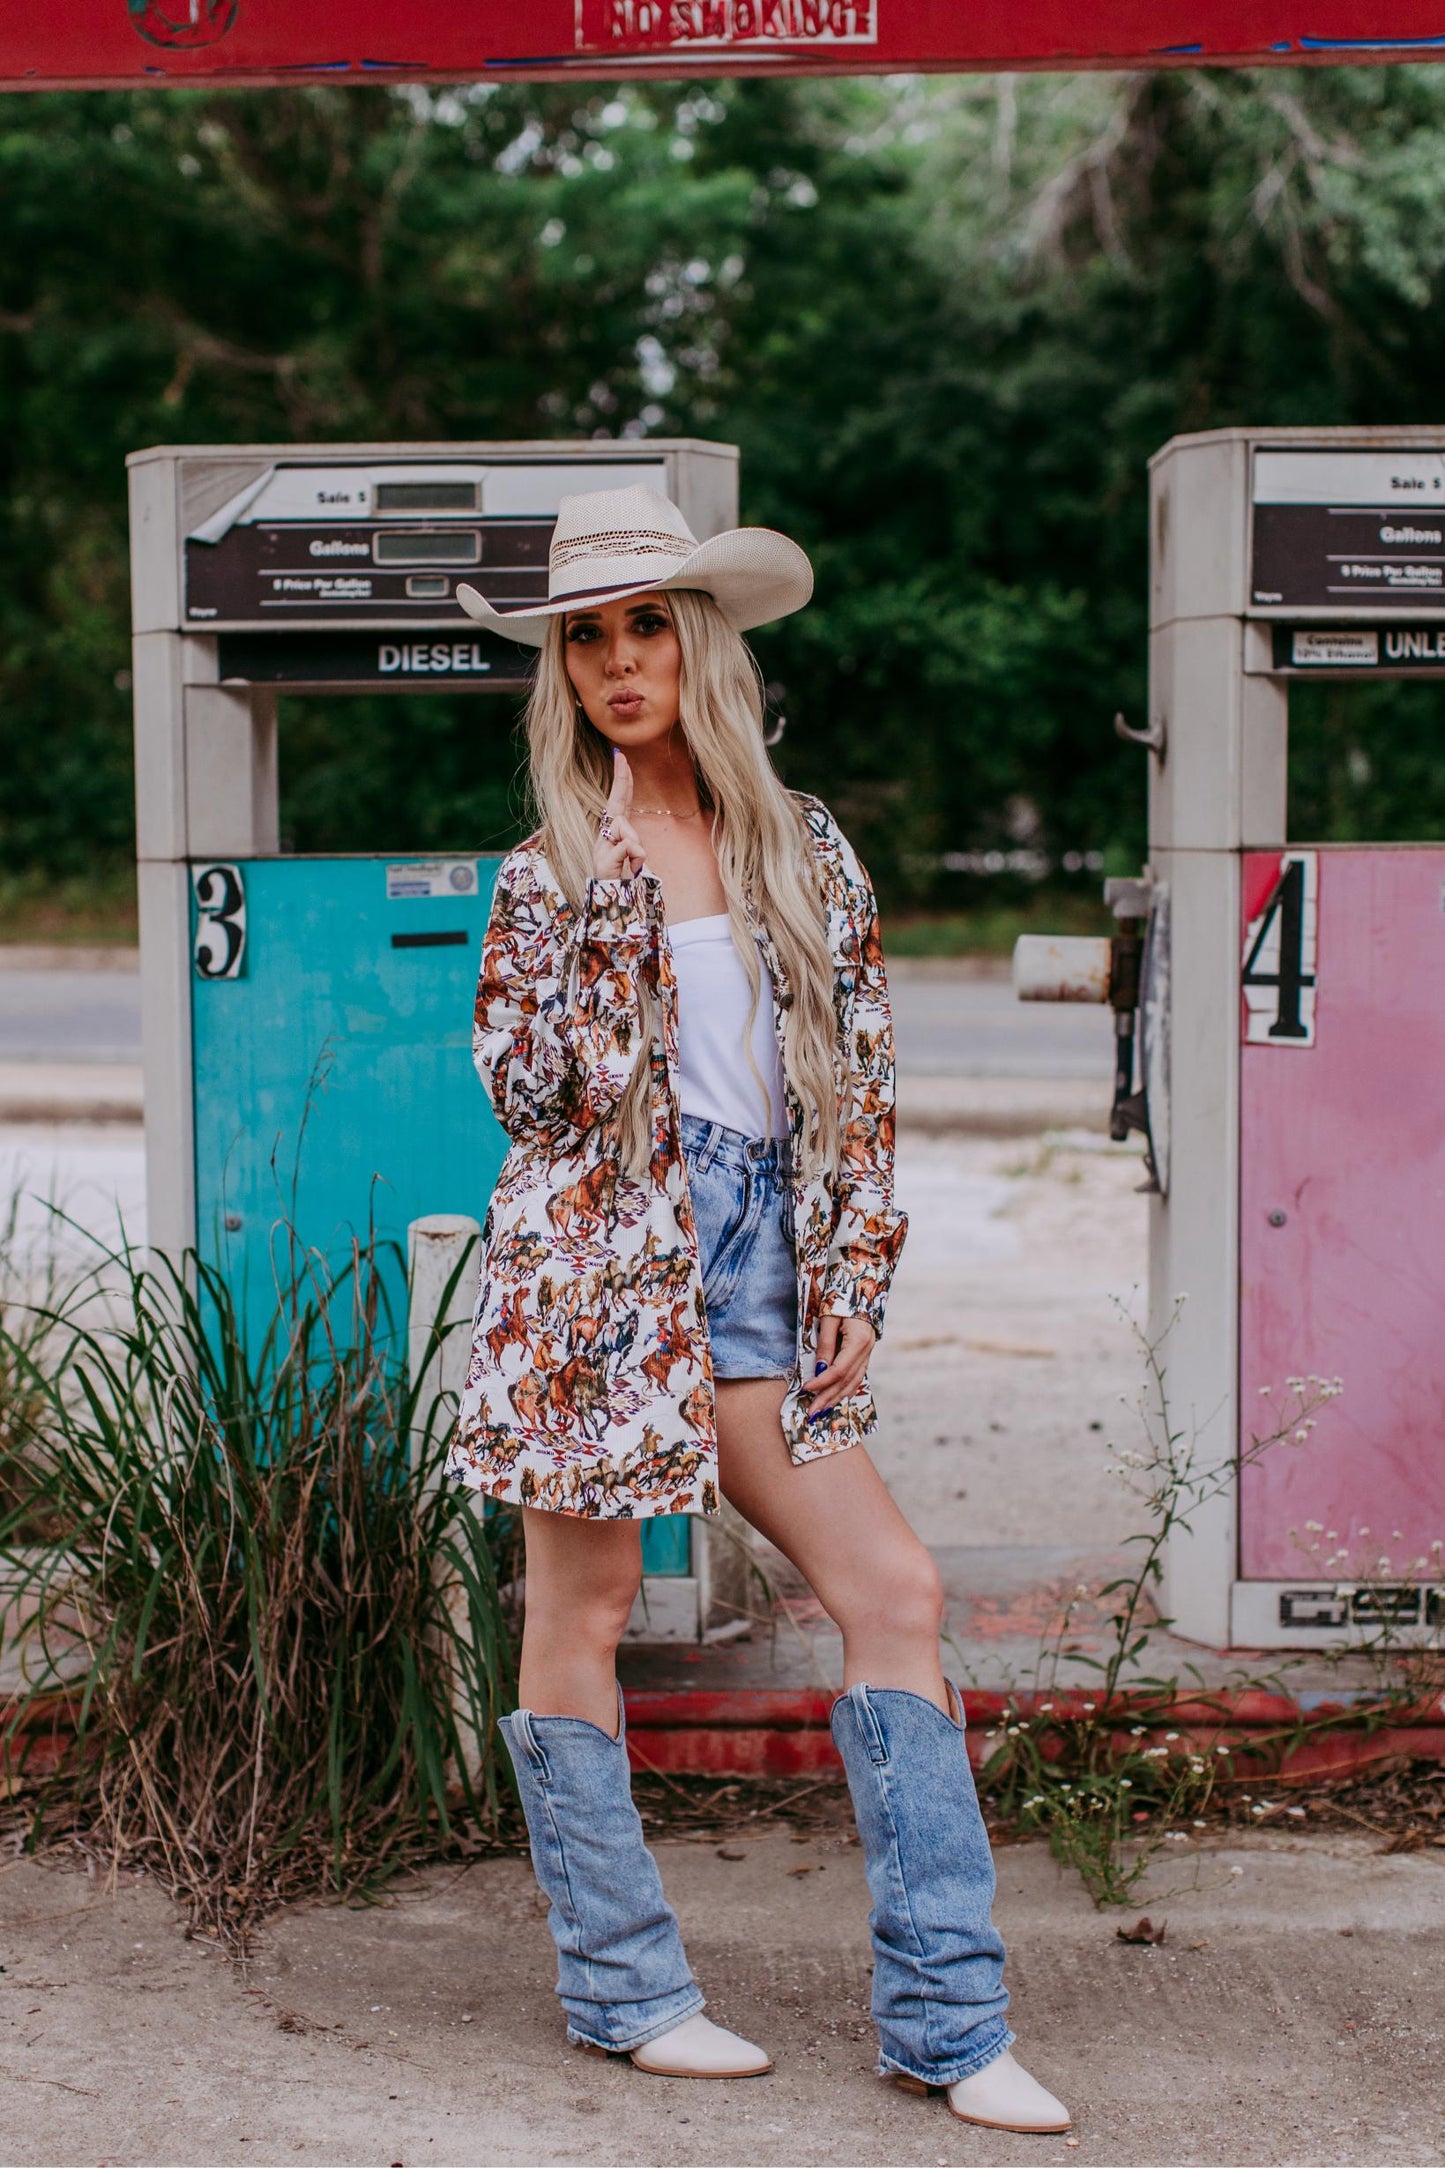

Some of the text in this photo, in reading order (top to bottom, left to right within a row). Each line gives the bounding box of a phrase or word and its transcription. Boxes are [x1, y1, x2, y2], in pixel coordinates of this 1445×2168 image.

[605, 0, 871, 40] NO SMOKING
[1390, 477, 1441, 489] Sale $
[317, 491, 366, 503] Sale $
[1380, 526, 1442, 544] Gallons
[309, 540, 370, 556] Gallons
[1351, 565, 1382, 578] Price
[1382, 565, 1403, 577] Per
[1404, 565, 1443, 577] Gallon
[283, 579, 312, 591] Price
[313, 579, 333, 590] Per
[334, 578, 372, 591] Gallon
[378, 644, 490, 671] DIESEL
[196, 867, 243, 977] 3
[1242, 861, 1315, 1038] 4
